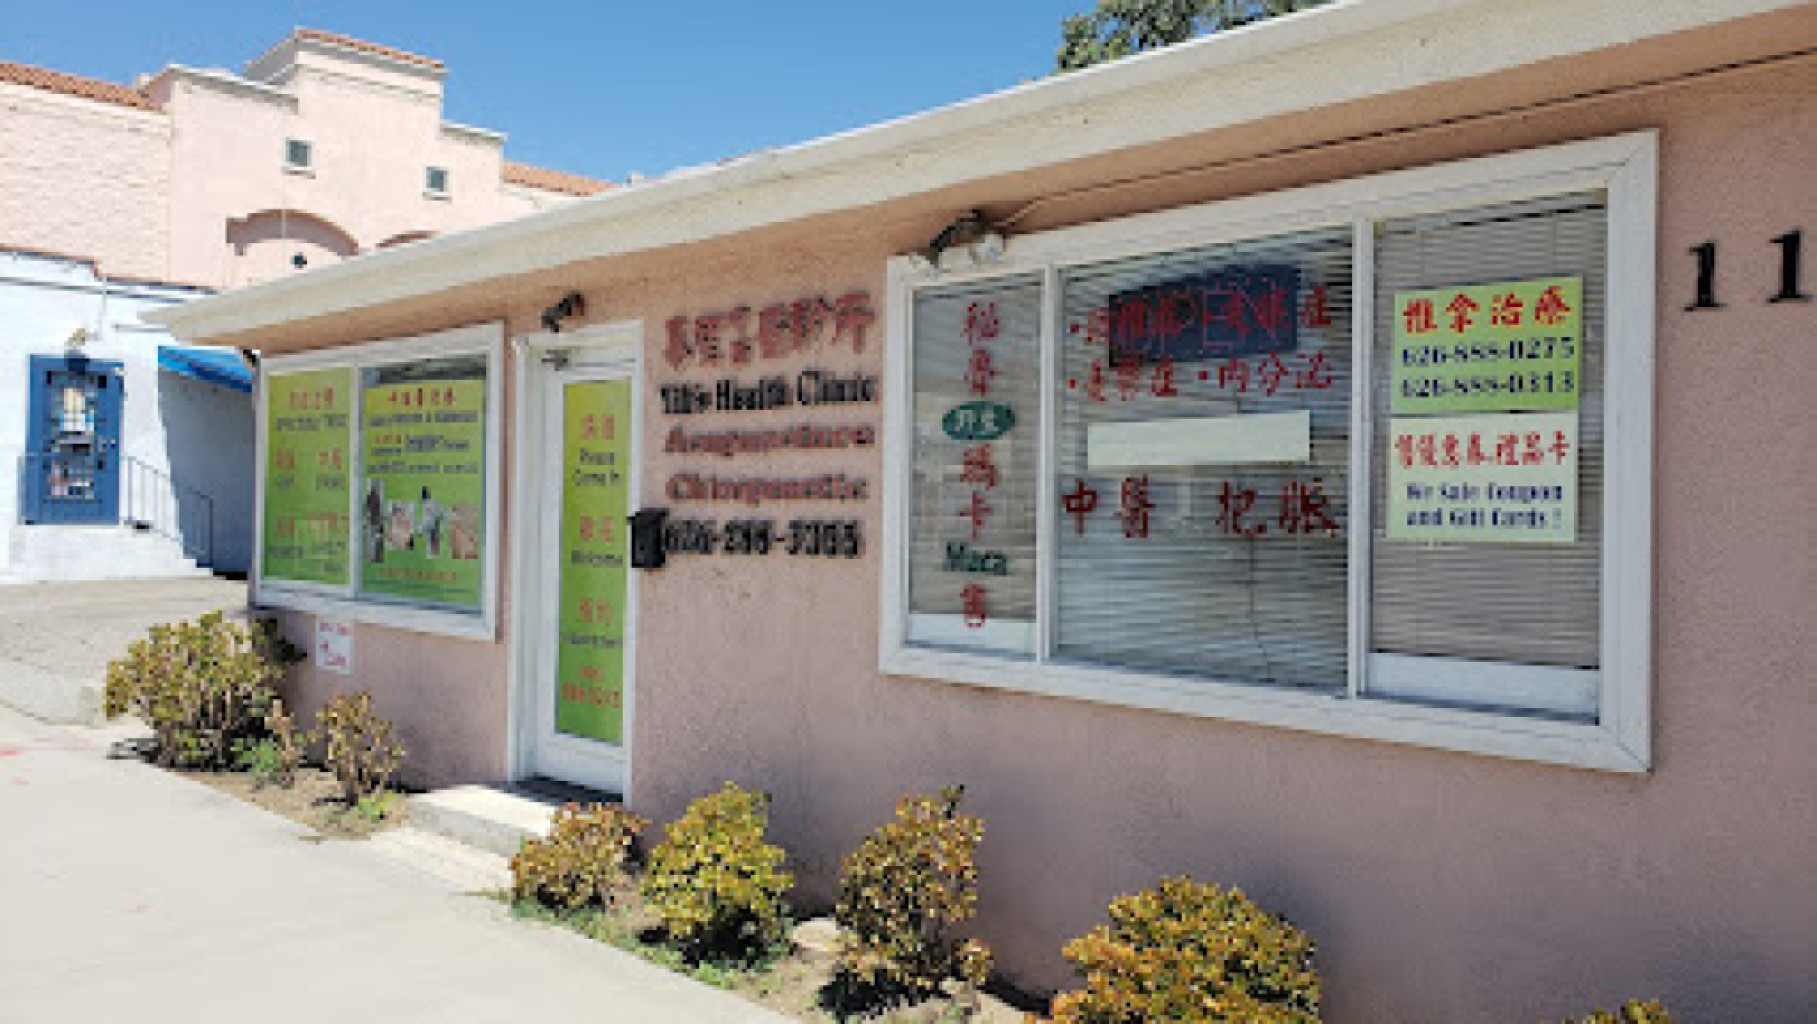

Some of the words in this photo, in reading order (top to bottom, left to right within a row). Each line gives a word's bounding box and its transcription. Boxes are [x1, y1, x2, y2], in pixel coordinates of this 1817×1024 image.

[1402, 286, 1572, 336] 推拿治療
[1402, 337, 1575, 367] 626-888-0275
[715, 376, 794, 412] Health
[796, 369, 878, 408] Clinic
[1402, 371, 1575, 398] 626-888-0313
[1061, 473, 1157, 539] 中醫
[1406, 483, 1434, 503] We
[1488, 482, 1563, 505] Coupon
[1406, 507, 1442, 527] and
[947, 544, 1008, 577] Maca
